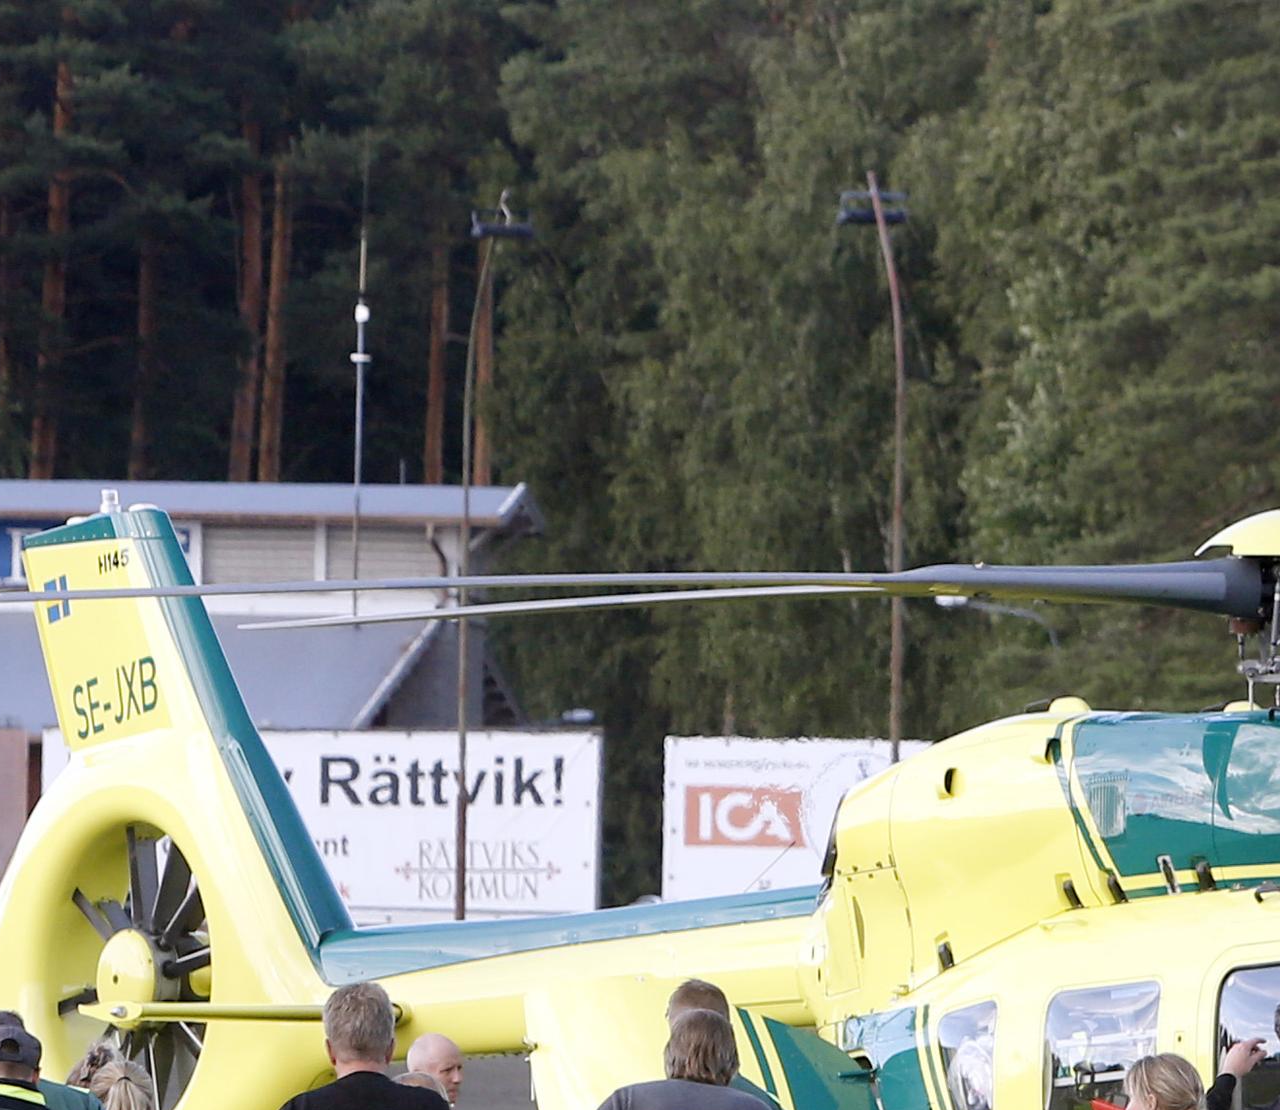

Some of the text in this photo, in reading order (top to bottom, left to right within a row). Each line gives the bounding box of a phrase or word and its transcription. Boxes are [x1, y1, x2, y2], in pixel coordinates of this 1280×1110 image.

[98, 549, 129, 575] H145
[73, 656, 158, 739] SE-JXB
[320, 756, 564, 806] Rättvik!
[698, 791, 791, 842] ICA
[418, 838, 540, 867] RÄTVIKS
